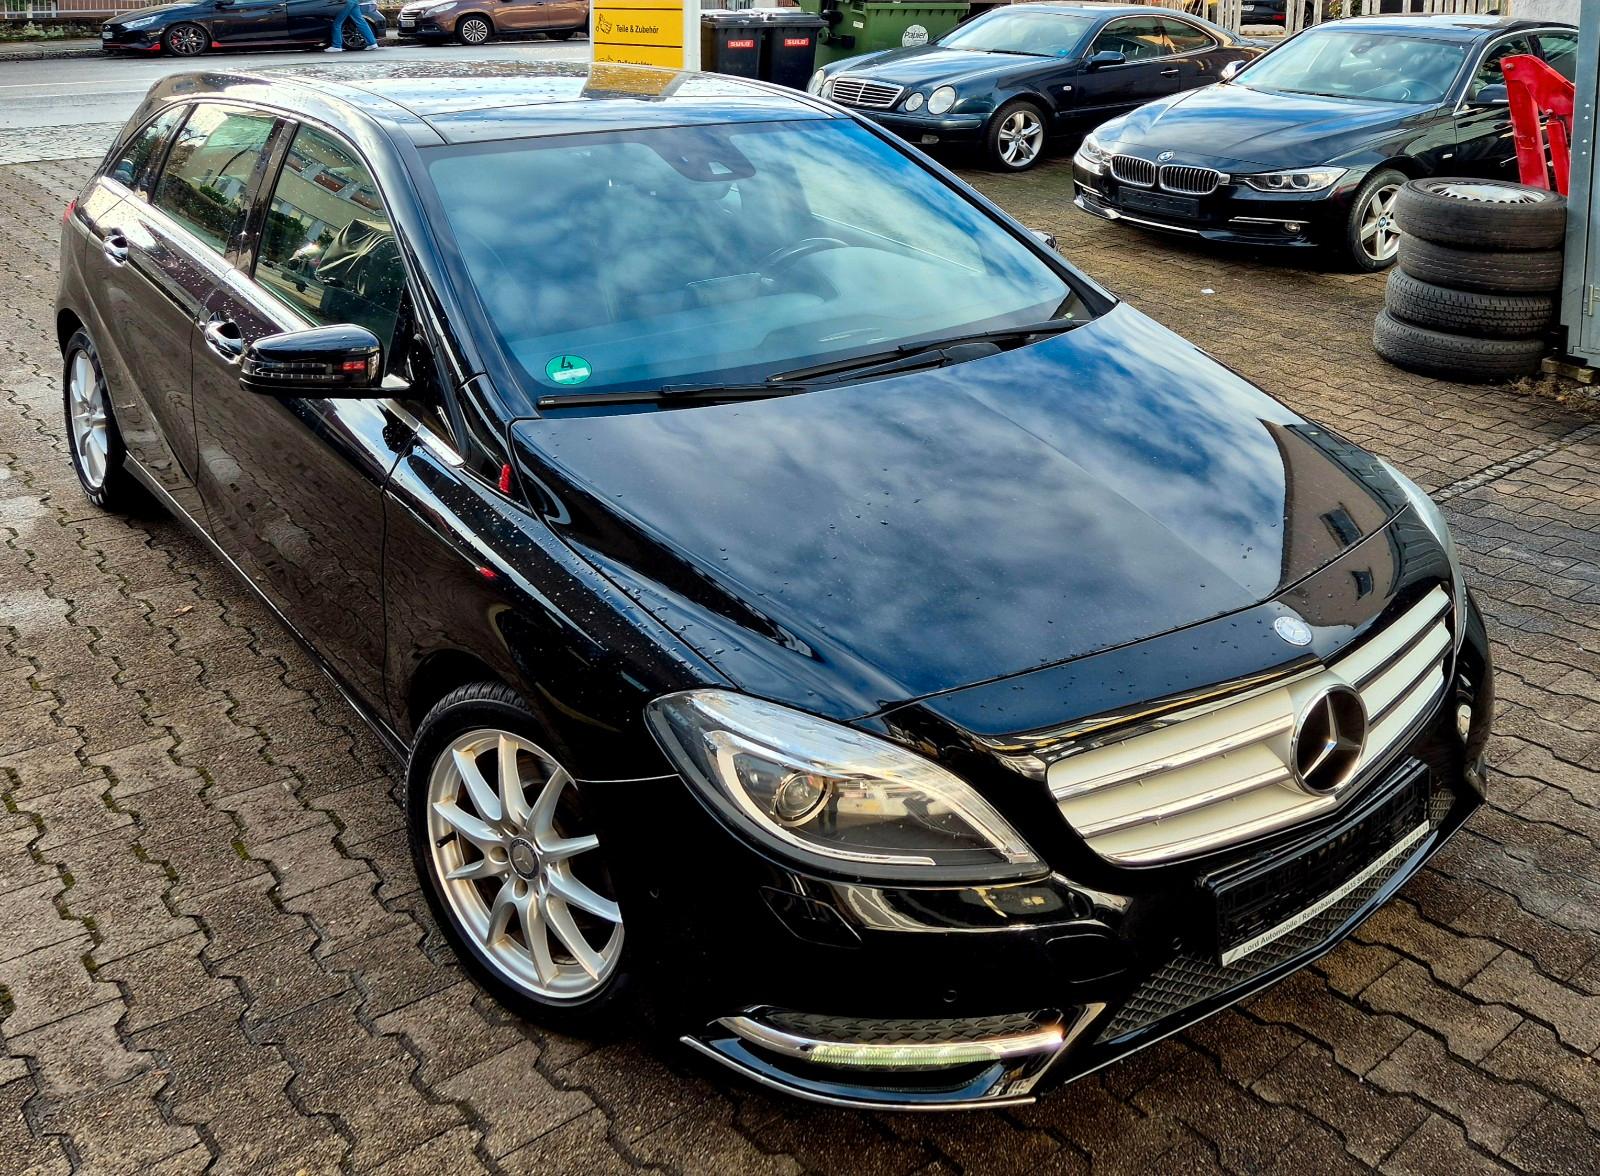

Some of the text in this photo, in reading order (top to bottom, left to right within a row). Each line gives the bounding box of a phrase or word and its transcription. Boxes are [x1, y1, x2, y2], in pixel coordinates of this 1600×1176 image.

[616, 24, 660, 34] Teile & Zubehör
[560, 356, 574, 369] 4
[1242, 941, 1260, 954] Lord
[1260, 920, 1298, 943] Automobile
